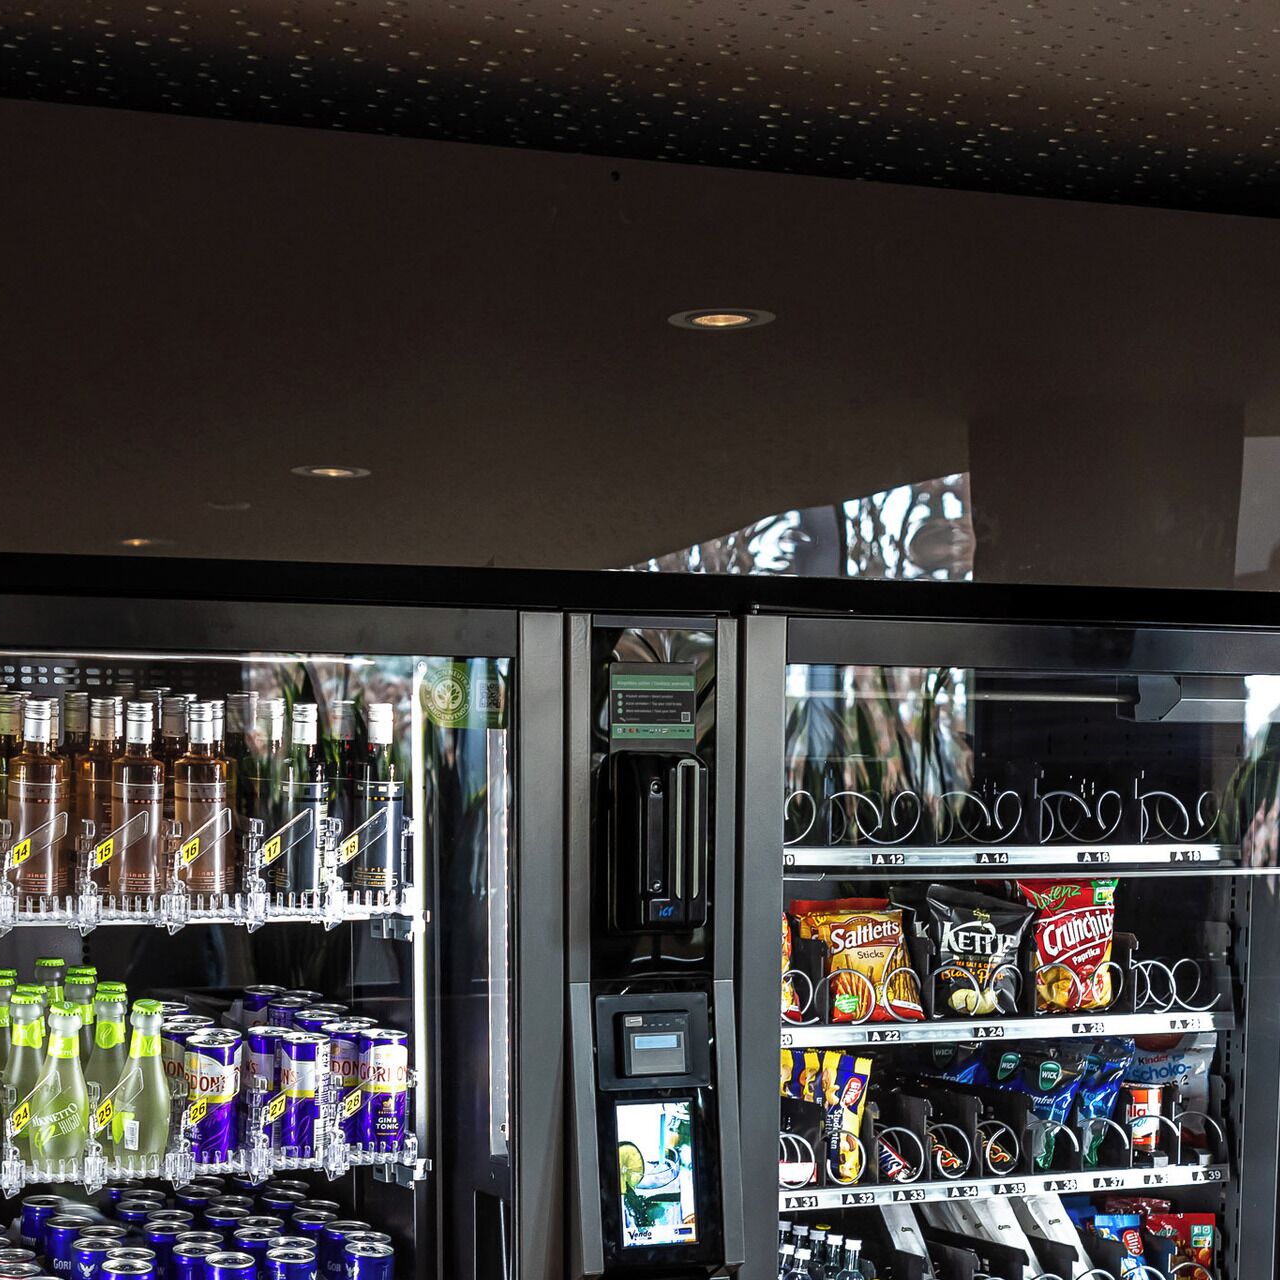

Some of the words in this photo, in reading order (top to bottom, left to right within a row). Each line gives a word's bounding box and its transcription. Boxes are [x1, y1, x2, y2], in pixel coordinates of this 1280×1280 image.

[14, 844, 28, 860] 14
[98, 843, 112, 860] 15
[184, 842, 198, 858] 16
[266, 841, 279, 857] 17
[344, 840, 356, 856] 18
[876, 855, 884, 864] A
[890, 854, 903, 864] 12
[981, 854, 989, 862] A
[994, 853, 1007, 862] 14
[830, 921, 900, 954] Saltletts
[940, 920, 1018, 956] KETTLE
[857, 950, 885, 960] Sticks
[871, 1032, 879, 1040] A
[885, 1032, 900, 1040] 22
[978, 1029, 986, 1037] A
[990, 1028, 1003, 1036] 24
[1042, 1070, 1057, 1080] WICK
[192, 1103, 207, 1119] 26
[270, 1100, 285, 1118] 27
[346, 1096, 360, 1113] 28
[15, 1110, 28, 1127] 24
[99, 1105, 111, 1122] 25
[830, 1110, 842, 1150] Studnten
[1198, 1172, 1206, 1180] A
[1208, 1171, 1221, 1179] 39
[846, 1195, 854, 1203] A
[860, 1194, 873, 1202] 32
[951, 1188, 959, 1196] A
[964, 1187, 978, 1195] 34
[790, 1198, 798, 1207] A
[804, 1197, 817, 1206] 31
